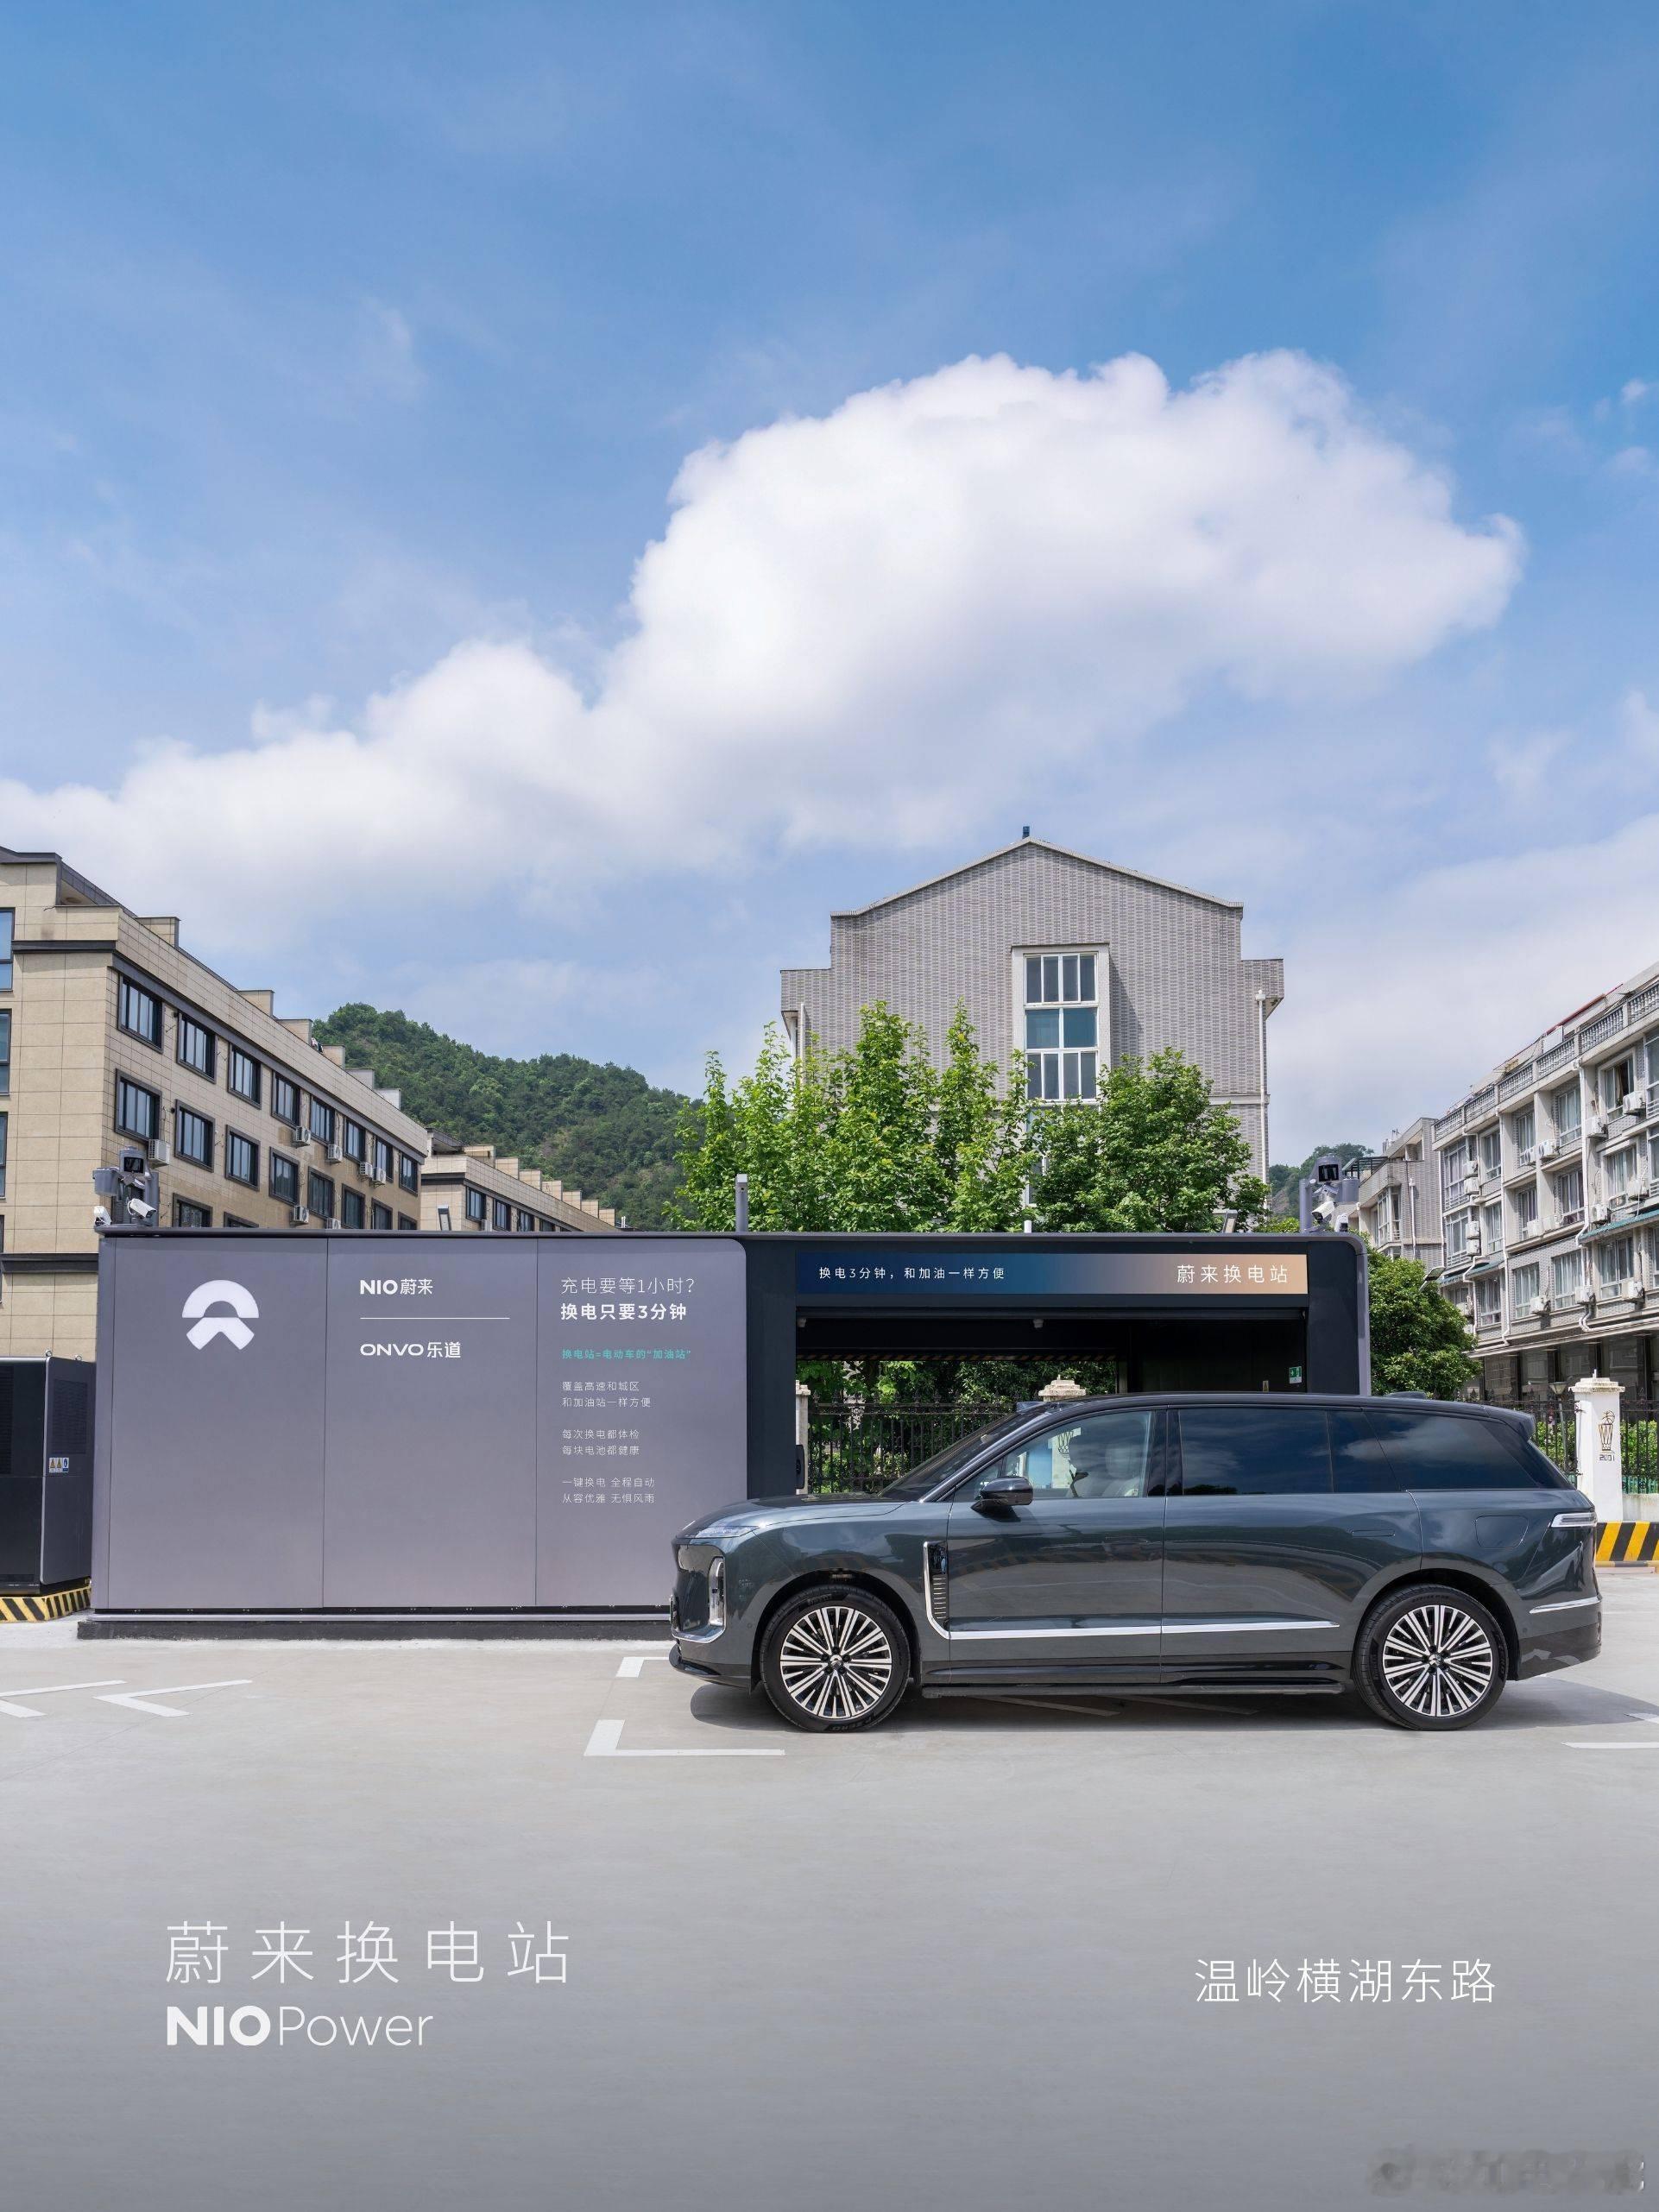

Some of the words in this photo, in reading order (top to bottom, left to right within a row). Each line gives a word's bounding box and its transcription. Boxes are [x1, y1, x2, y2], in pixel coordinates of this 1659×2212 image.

[818, 1266, 1006, 1280] 换电3分钟，和加油一样方便
[1176, 1264, 1289, 1284] 蔚来换电站
[560, 1276, 695, 1295] 充电要等1小时？
[560, 1302, 687, 1320] 换电只要3分钟
[561, 1381, 640, 1391] 覆盖高速和城区
[561, 1396, 652, 1408] 和加油站一样方便
[561, 1428, 640, 1440] 每次换电都体检
[561, 1445, 640, 1456] 每块电池都健康
[562, 1477, 606, 1488] 一键换电
[610, 1477, 655, 1488] 全程自动
[562, 1493, 606, 1503] 从容优雅
[610, 1493, 655, 1503] 无惧风雨
